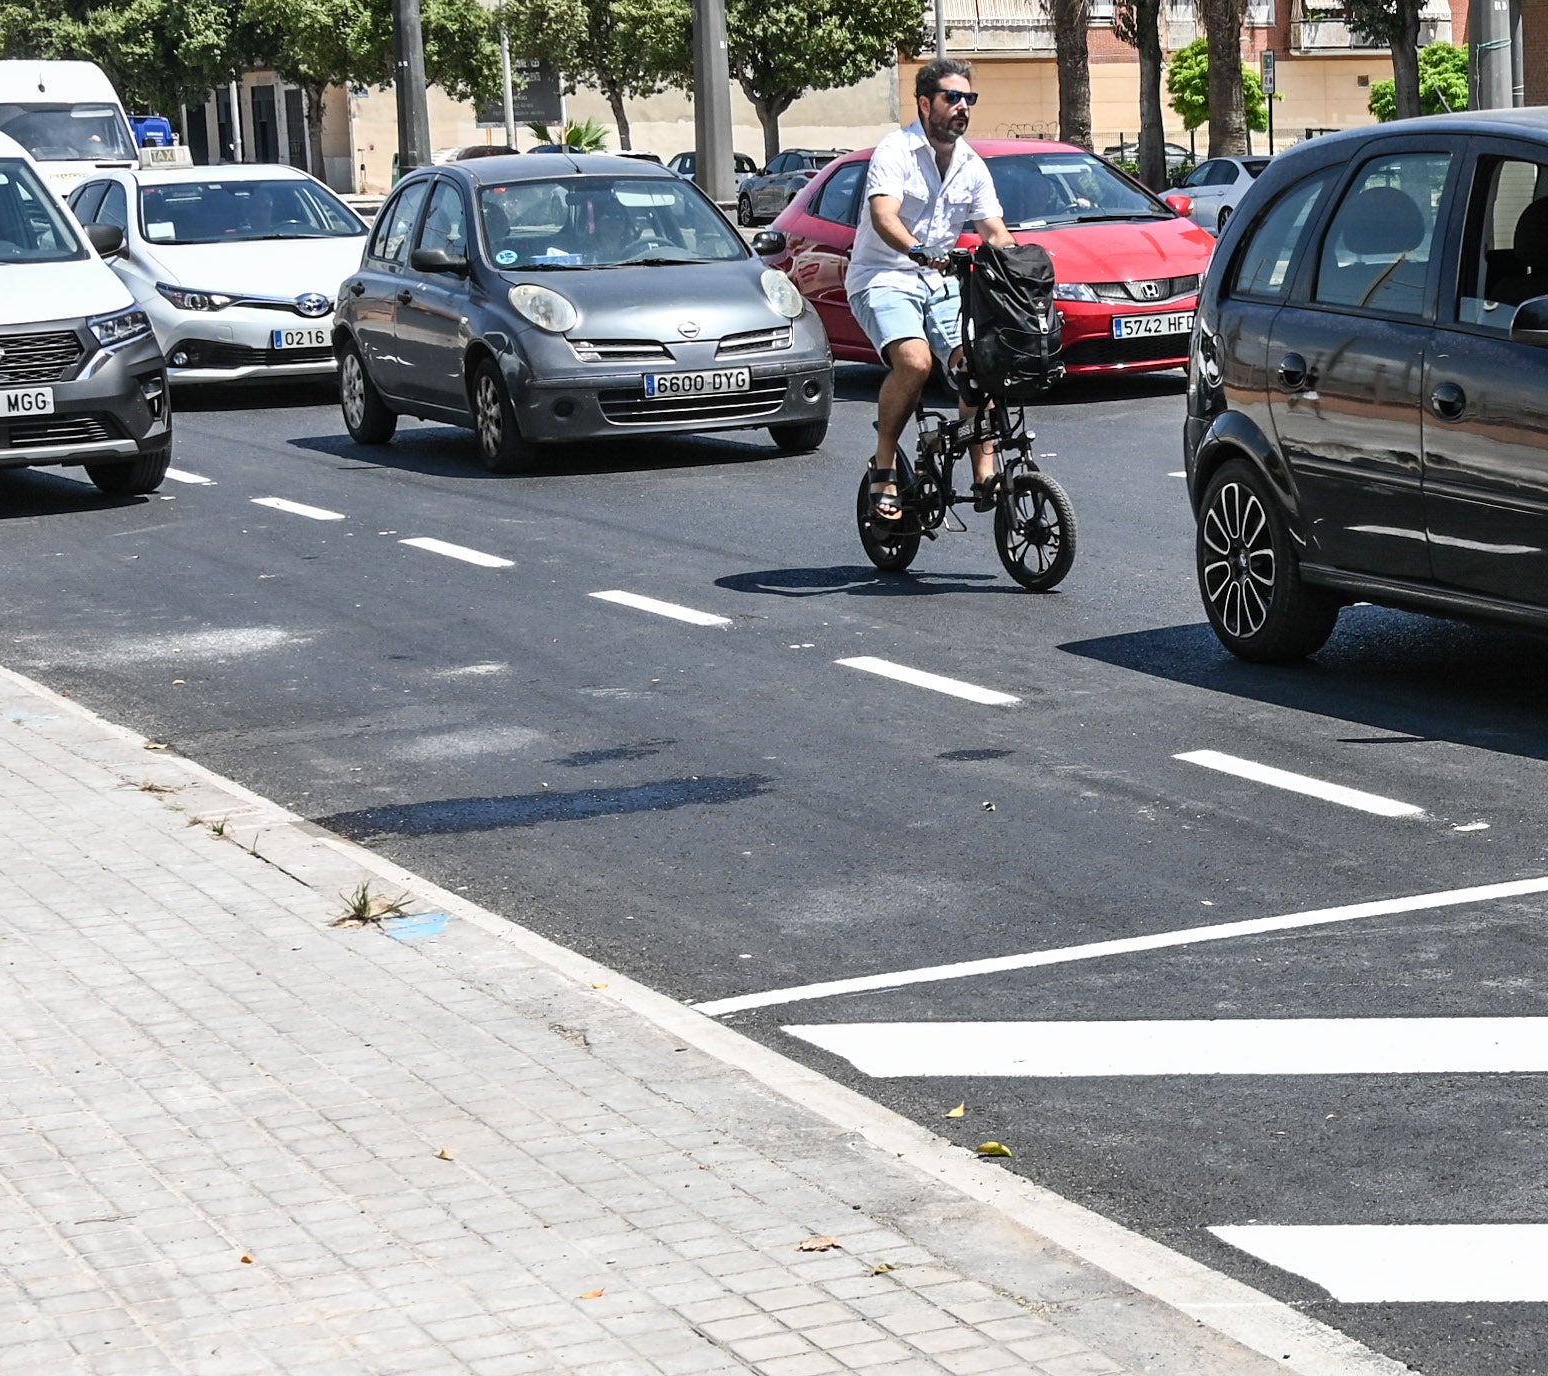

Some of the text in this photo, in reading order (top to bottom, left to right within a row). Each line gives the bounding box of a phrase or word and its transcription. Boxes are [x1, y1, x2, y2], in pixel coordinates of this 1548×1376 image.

[152, 149, 177, 162] TAXI
[1124, 318, 1162, 336] 5742
[285, 330, 325, 346] 0216
[657, 371, 746, 393] 6600 DYG
[7, 392, 47, 412] MGG
